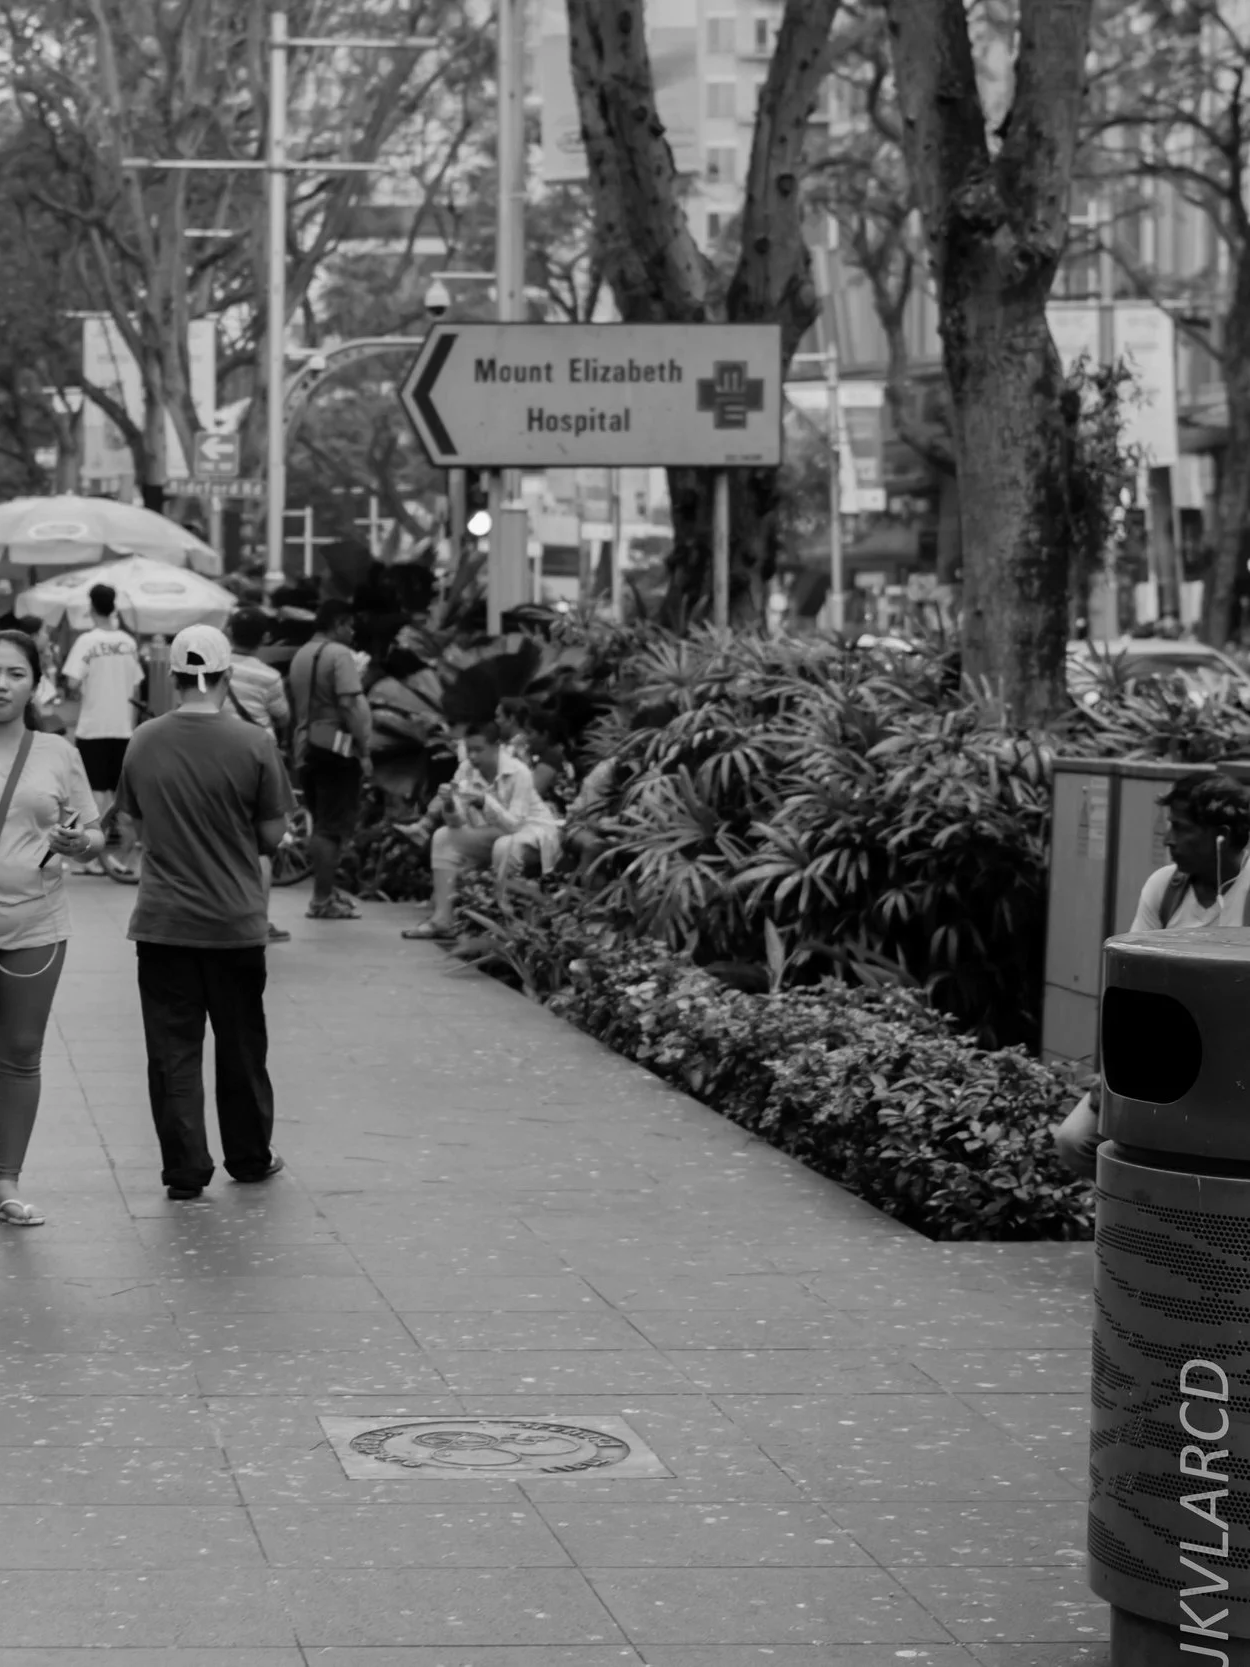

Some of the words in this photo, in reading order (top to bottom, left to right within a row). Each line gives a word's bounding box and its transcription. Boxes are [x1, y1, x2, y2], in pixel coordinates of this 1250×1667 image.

[474, 358, 554, 383] Mount
[568, 358, 683, 383] Elizabeth
[526, 406, 631, 437] Hospital
